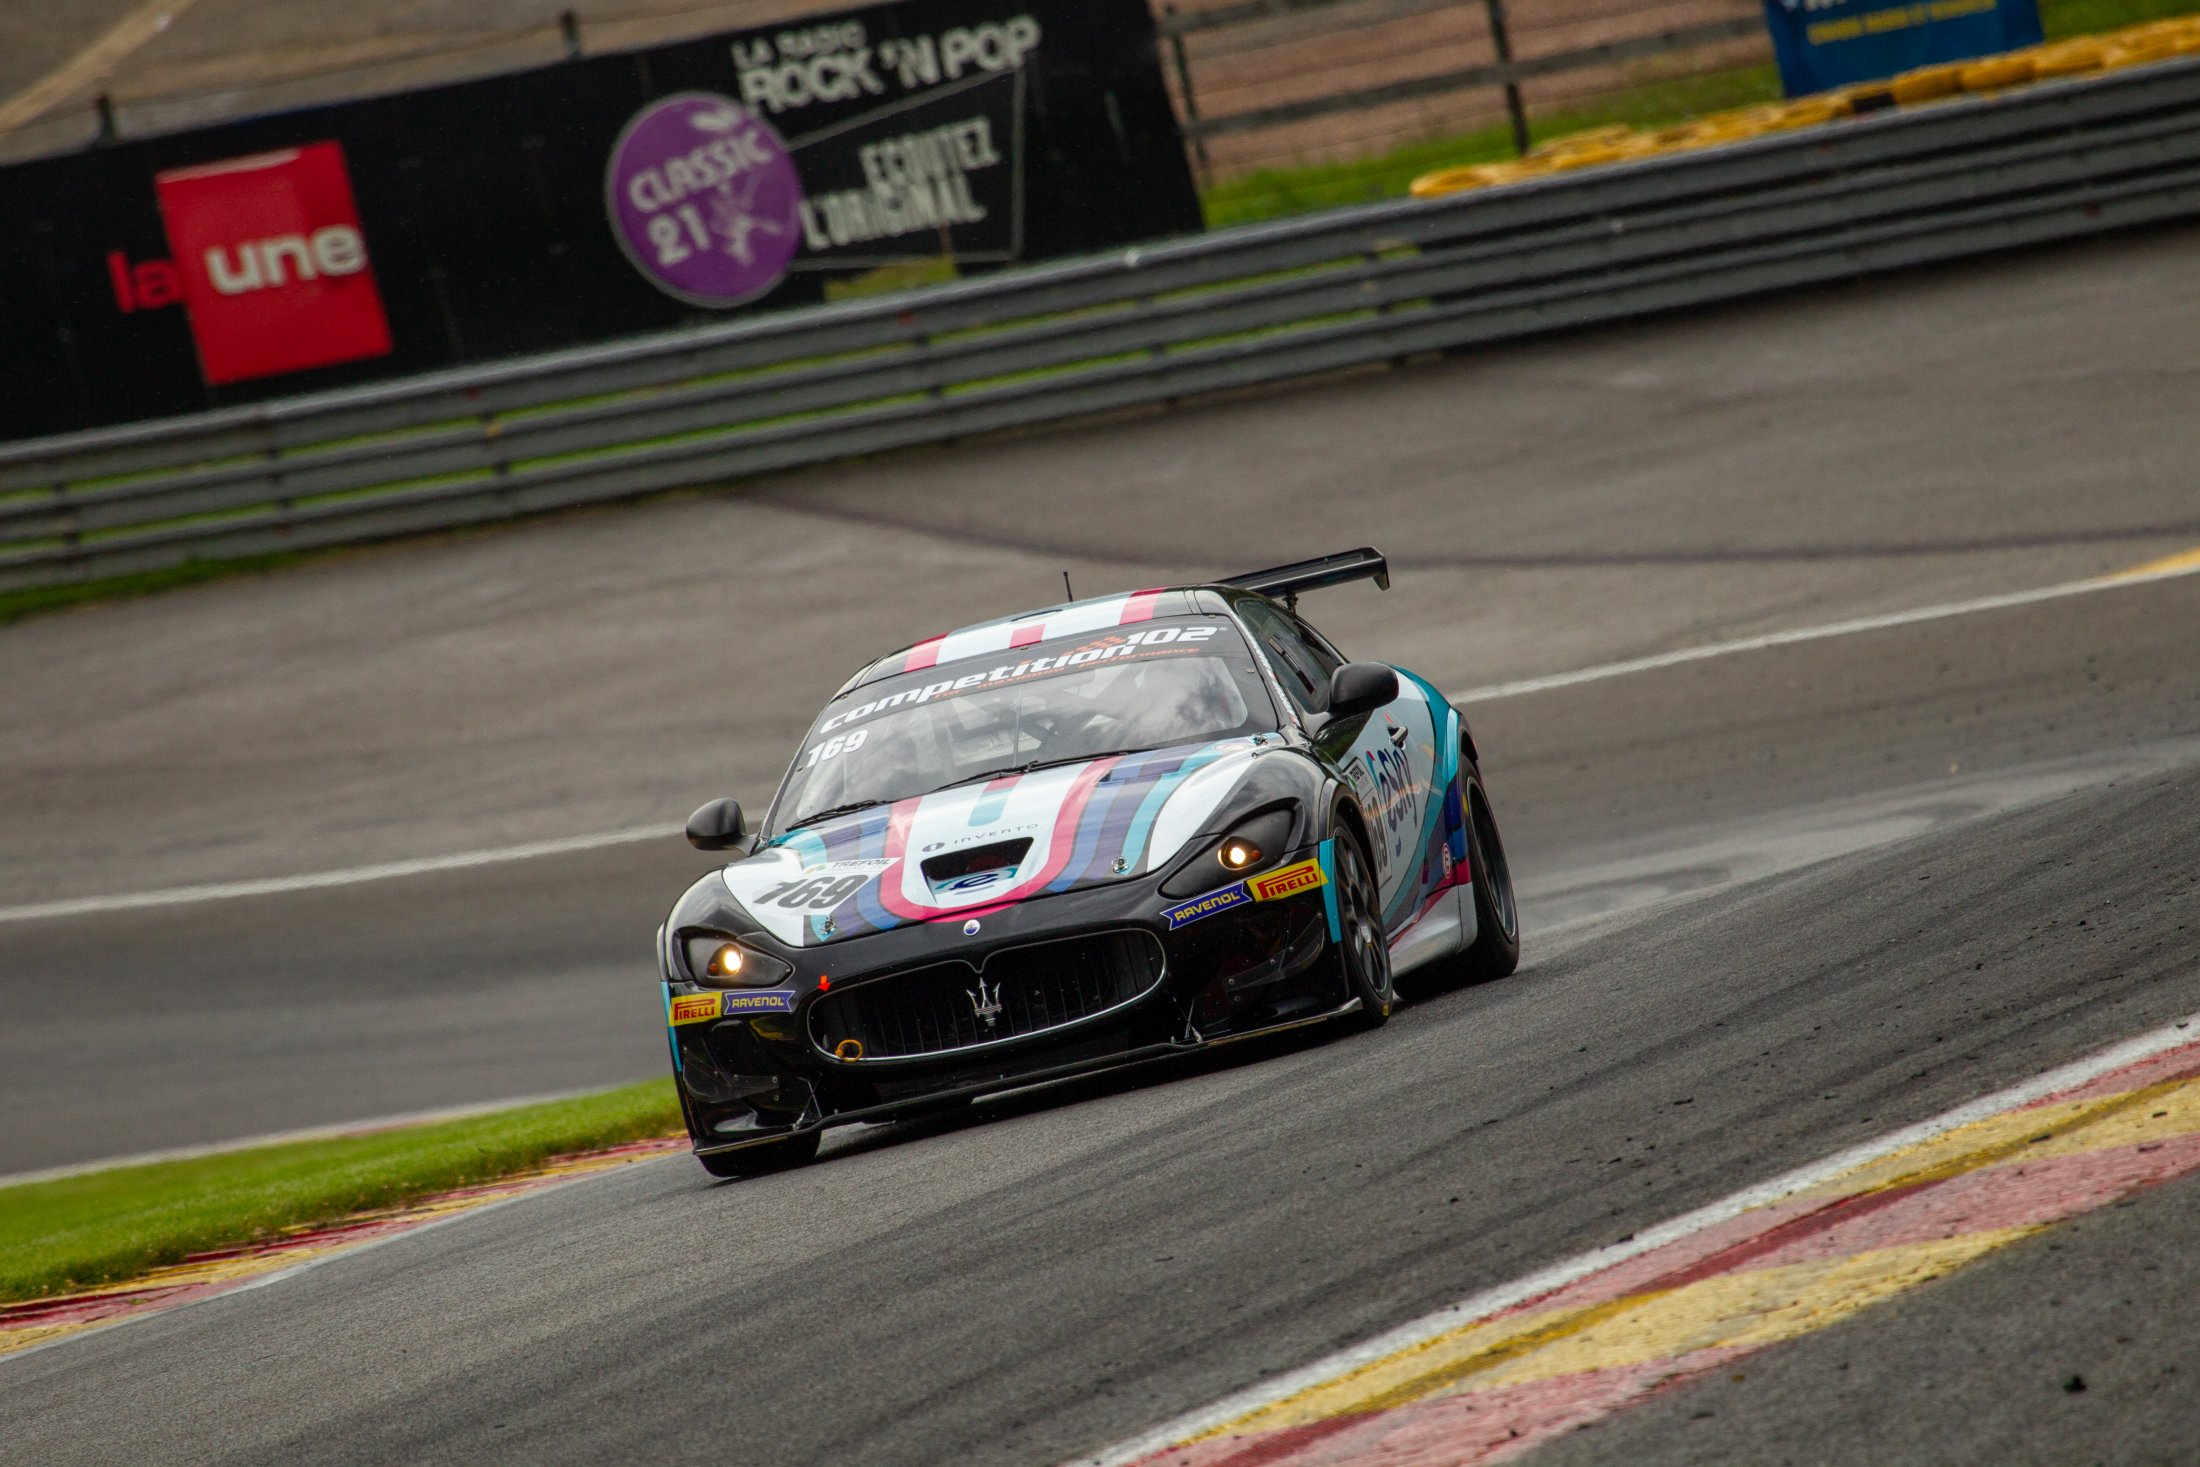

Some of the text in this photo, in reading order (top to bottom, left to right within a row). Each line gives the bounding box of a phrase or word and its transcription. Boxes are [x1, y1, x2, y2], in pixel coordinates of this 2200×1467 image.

[731, 39, 774, 71] LA
[740, 47, 886, 114] ROCK
[941, 13, 1042, 80] POP
[628, 130, 775, 214] CLASSIC
[648, 205, 712, 268] 21
[107, 224, 367, 315] la une
[806, 729, 869, 768] 169
[832, 857, 891, 869] TREFOIL
[752, 874, 869, 910] 169
[1173, 865, 1319, 922] RAVENOL PIRELLI
[673, 996, 785, 1021] PIRELLI RAVENOL
